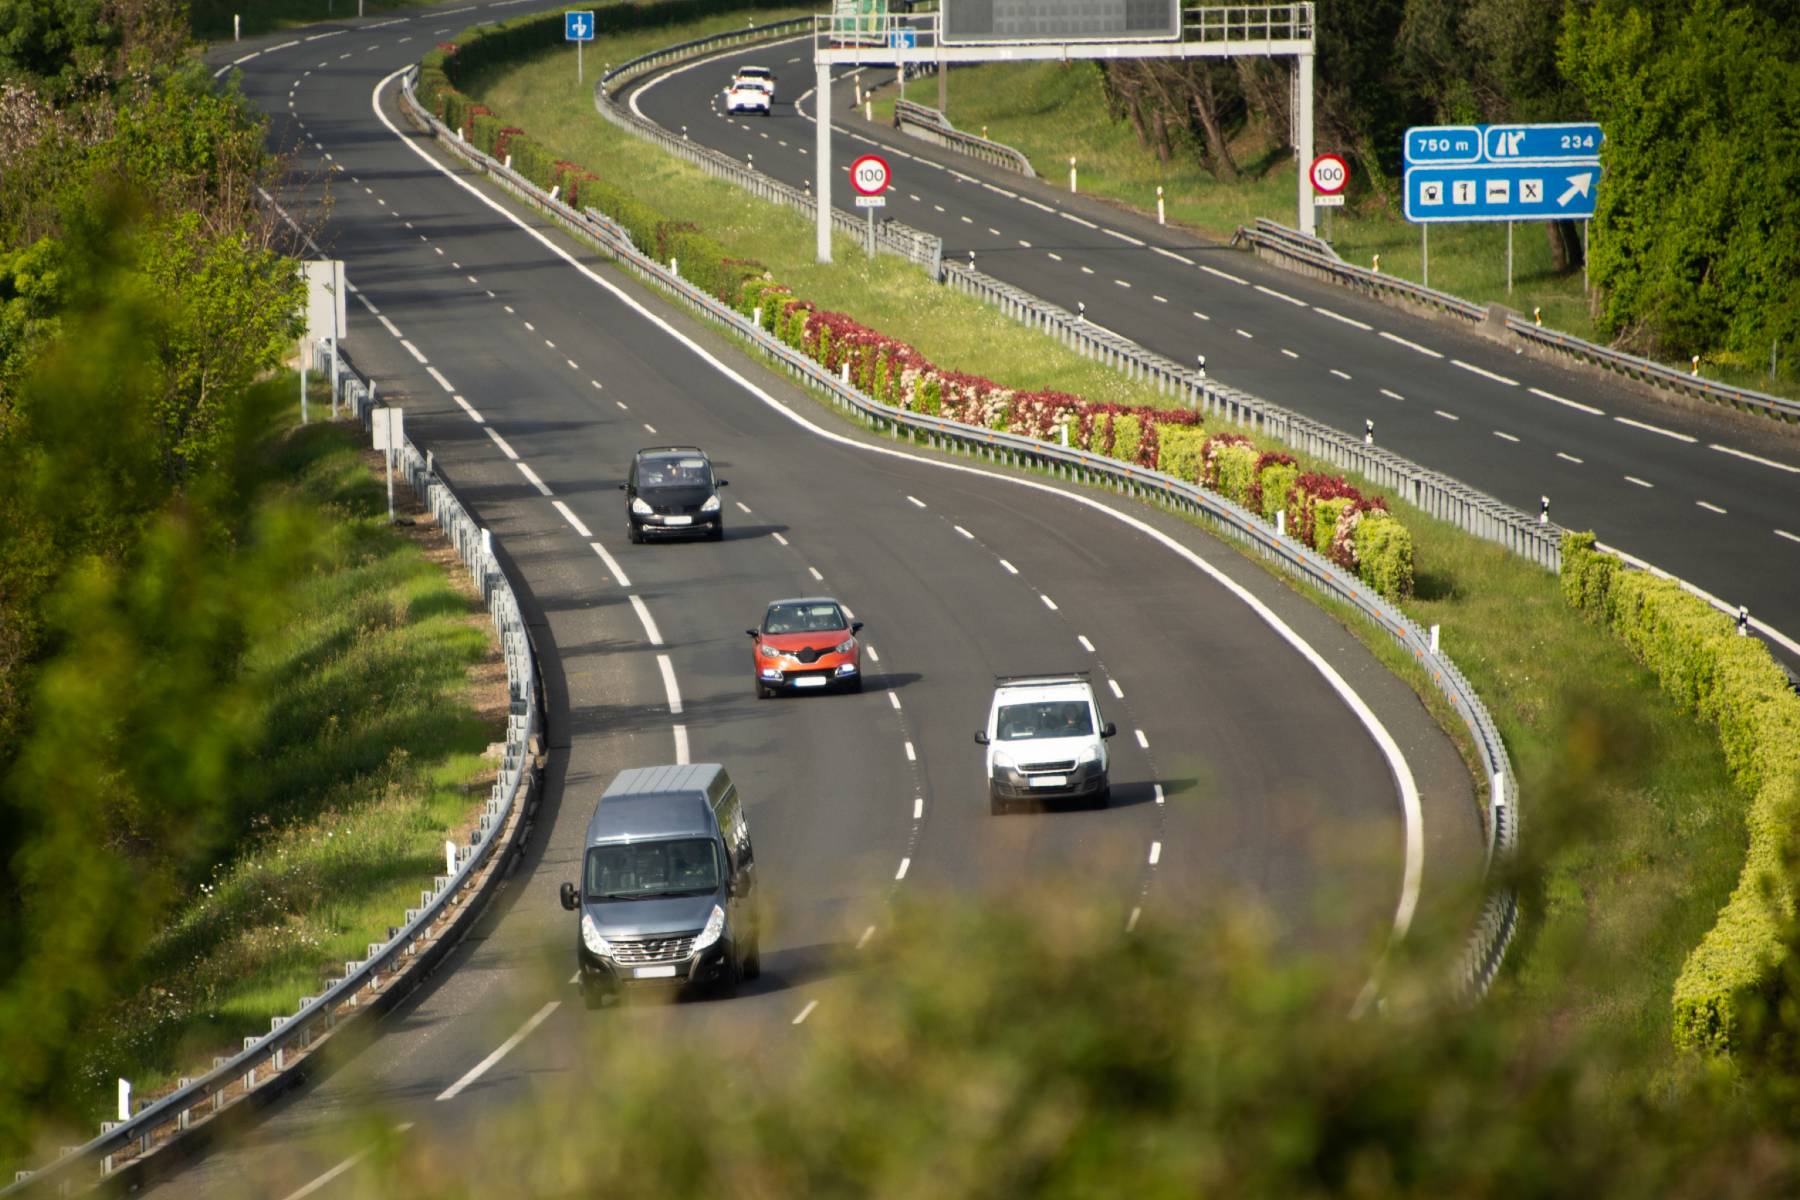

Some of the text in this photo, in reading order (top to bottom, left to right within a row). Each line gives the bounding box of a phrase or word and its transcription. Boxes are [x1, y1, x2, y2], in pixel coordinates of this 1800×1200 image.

[1418, 139, 1469, 152] 750 m
[1561, 135, 1594, 149] 234
[859, 169, 884, 182] 100
[1318, 168, 1343, 181] 100
